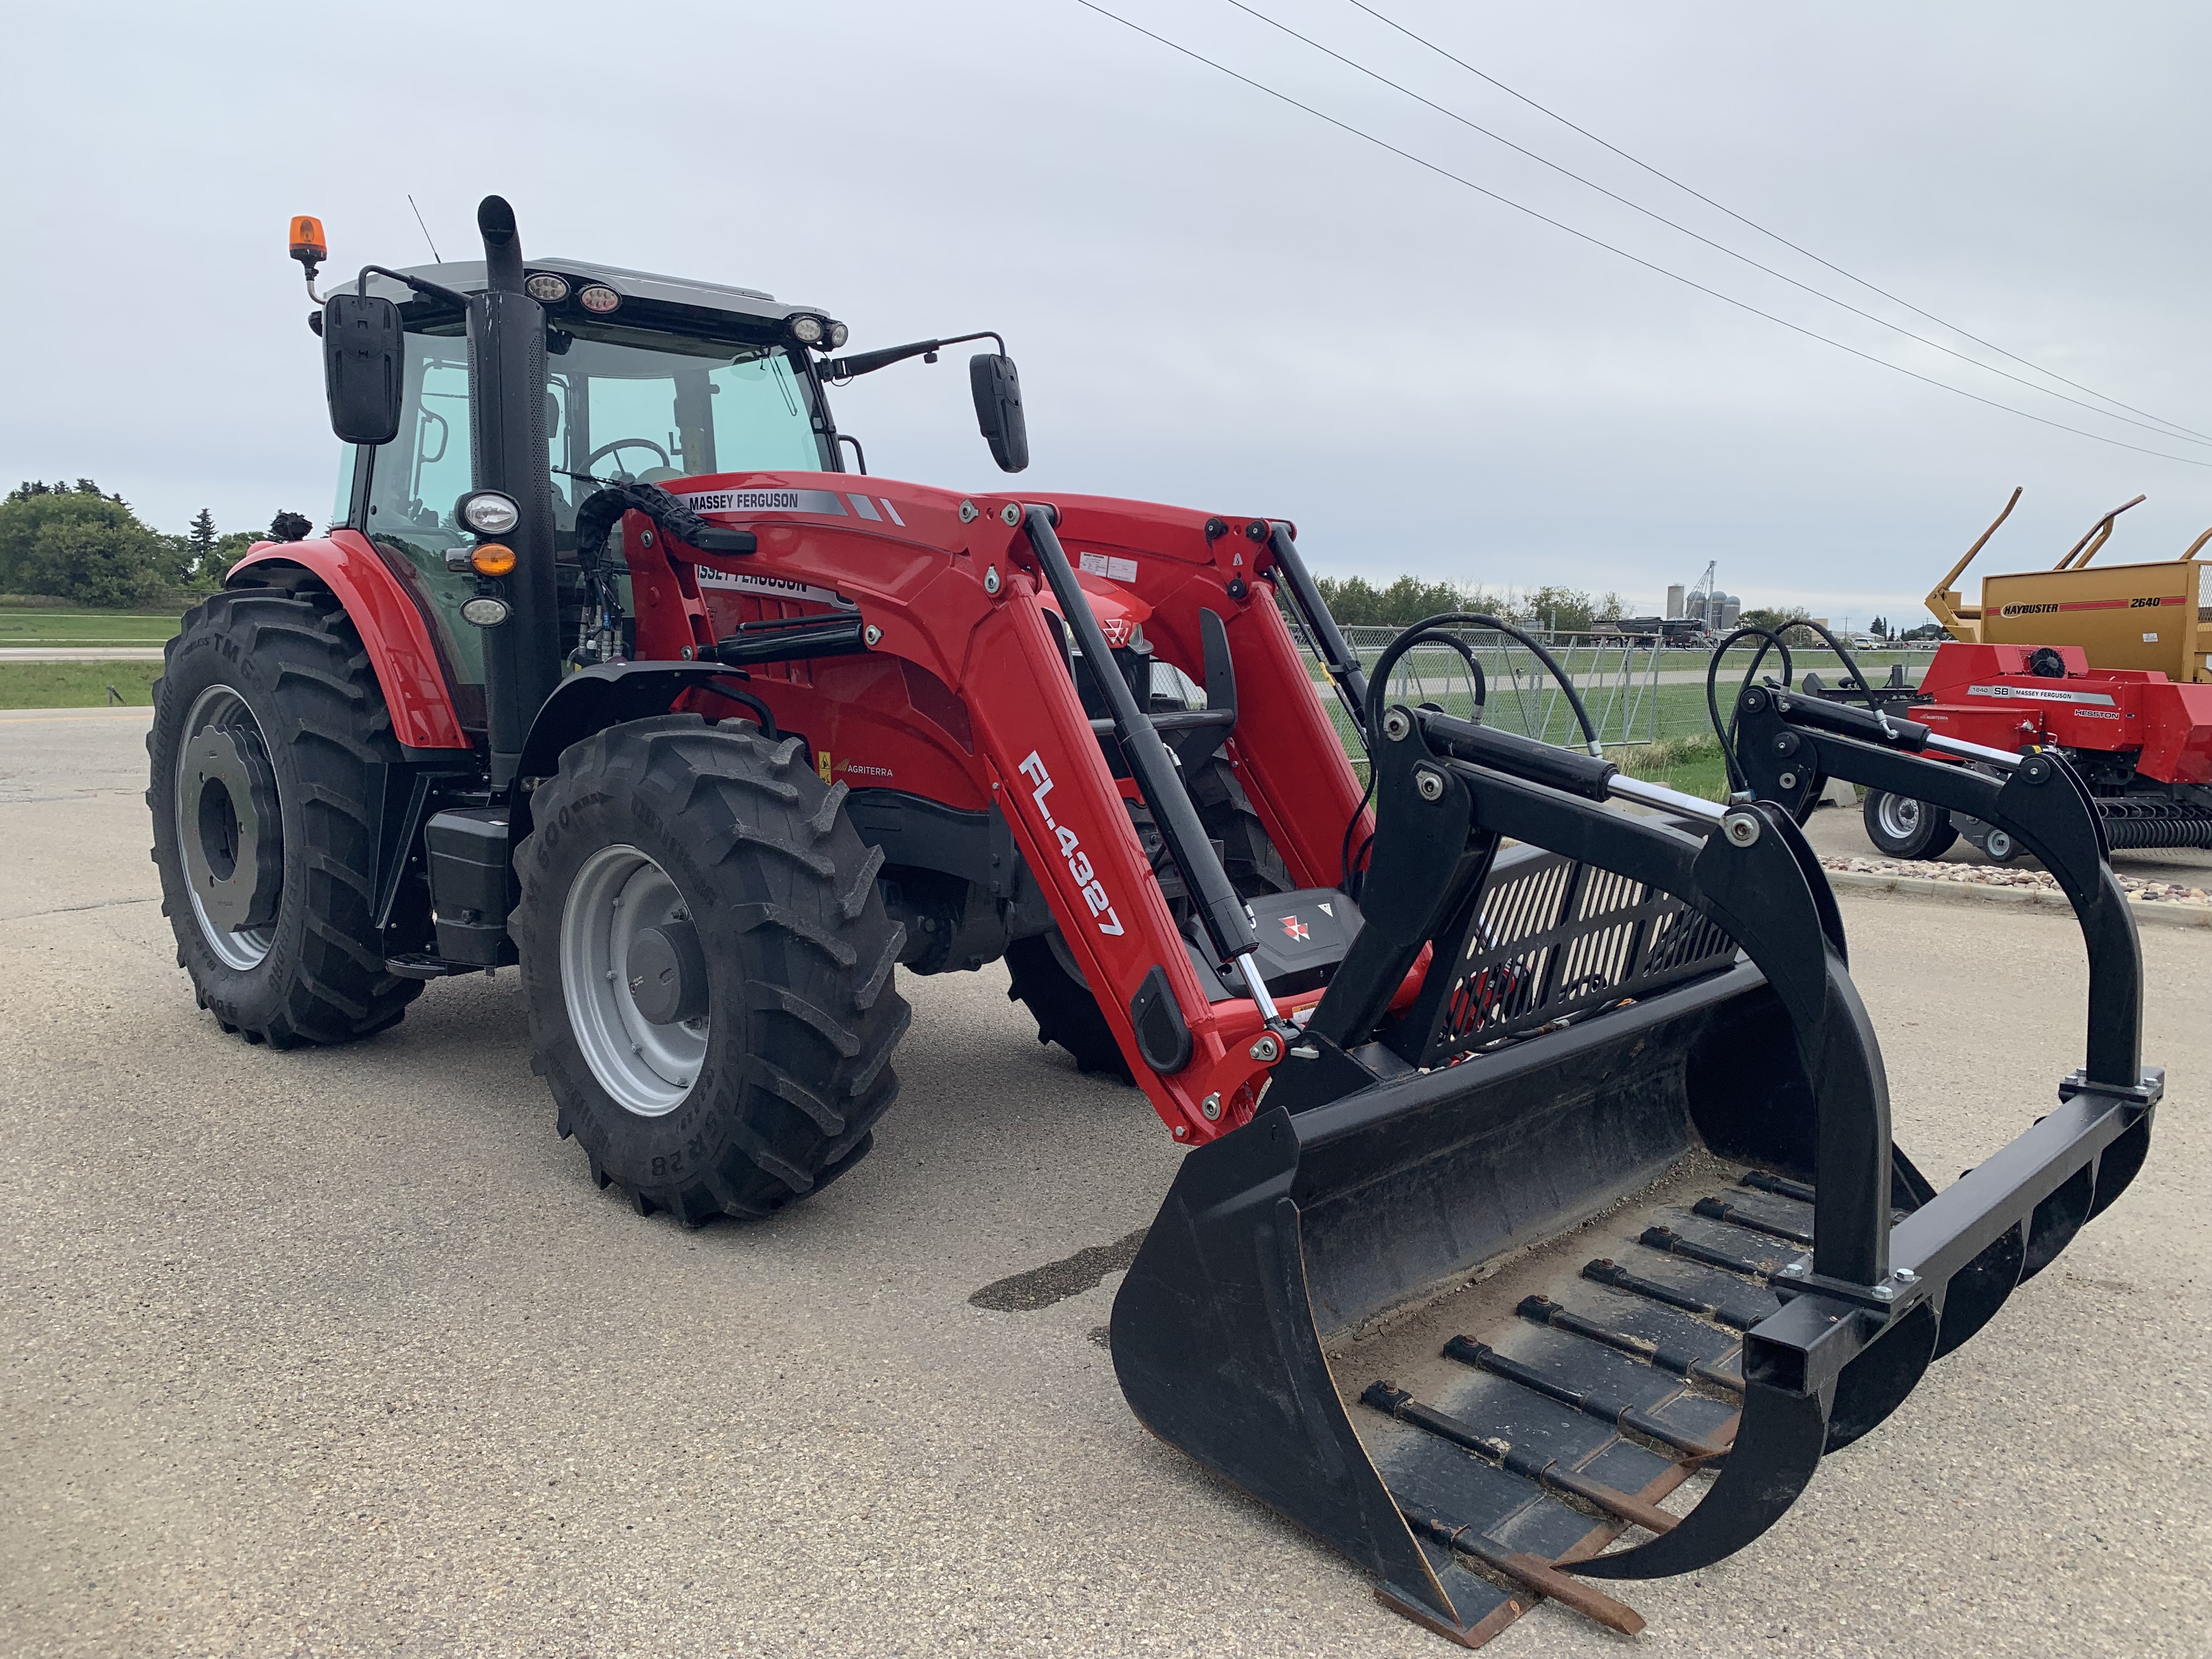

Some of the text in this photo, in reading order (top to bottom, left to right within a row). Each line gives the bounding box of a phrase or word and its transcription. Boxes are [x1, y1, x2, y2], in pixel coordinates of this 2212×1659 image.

[690, 493, 798, 510] MASSEY FERGUSON
[2130, 597, 2160, 608] 2640
[2004, 602, 2058, 615] HAYBUSTER
[1994, 687, 2009, 696] SB
[2075, 710, 2119, 719] HESSTON
[848, 765, 893, 777] AGRITERRA
